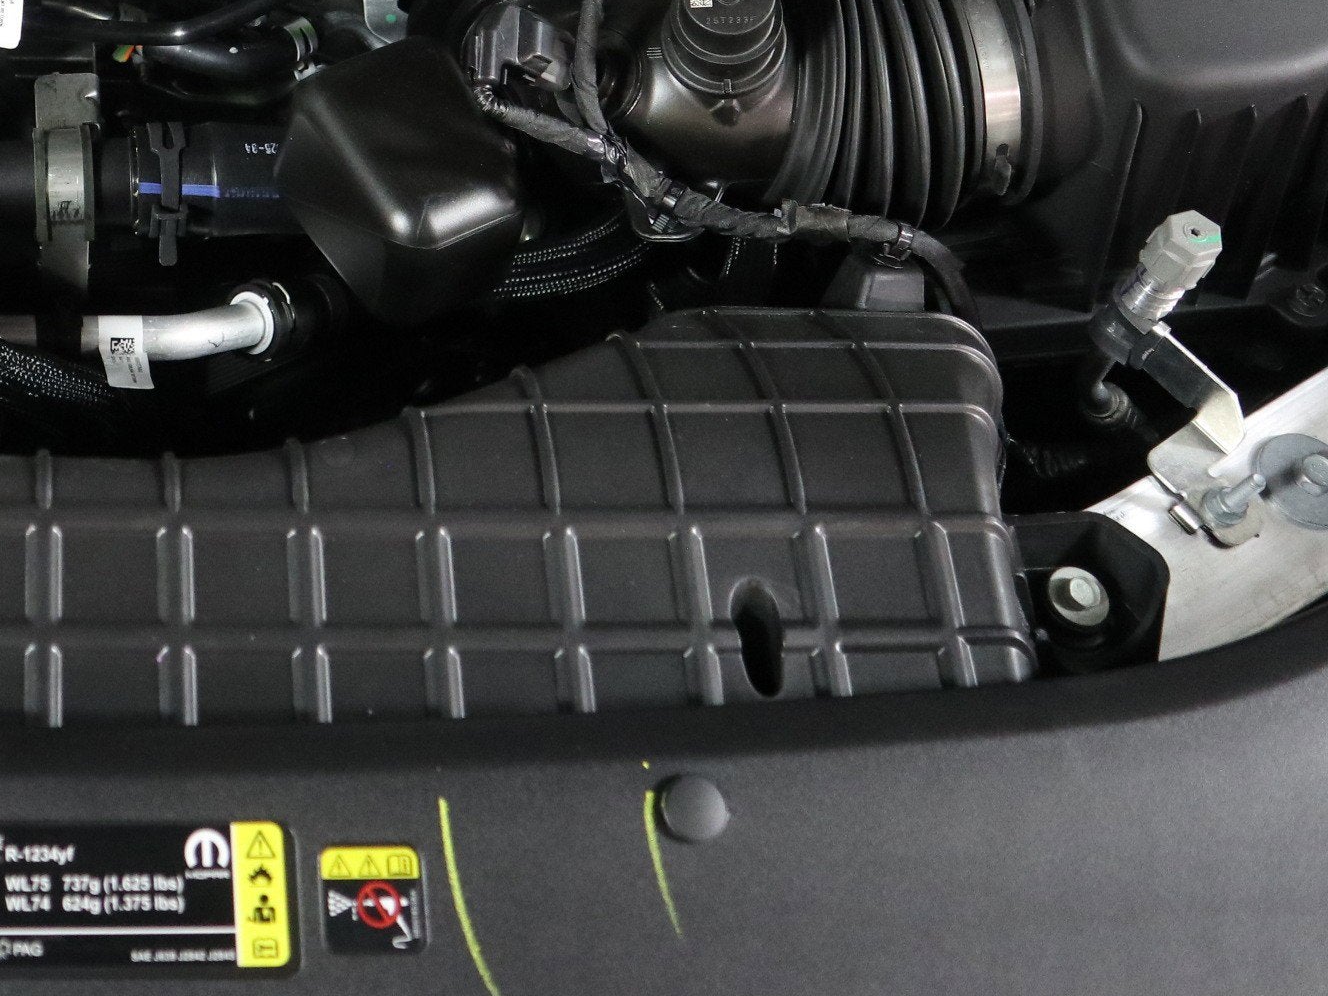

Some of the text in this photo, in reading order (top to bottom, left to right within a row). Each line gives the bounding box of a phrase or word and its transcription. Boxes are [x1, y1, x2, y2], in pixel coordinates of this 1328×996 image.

[4, 844, 76, 866] R-1234yf
[4, 874, 185, 896] WL75 737g (1.625 lbs)
[4, 894, 185, 916] WL74 624g (1.375 lbs)
[12, 940, 44, 957] PAG
